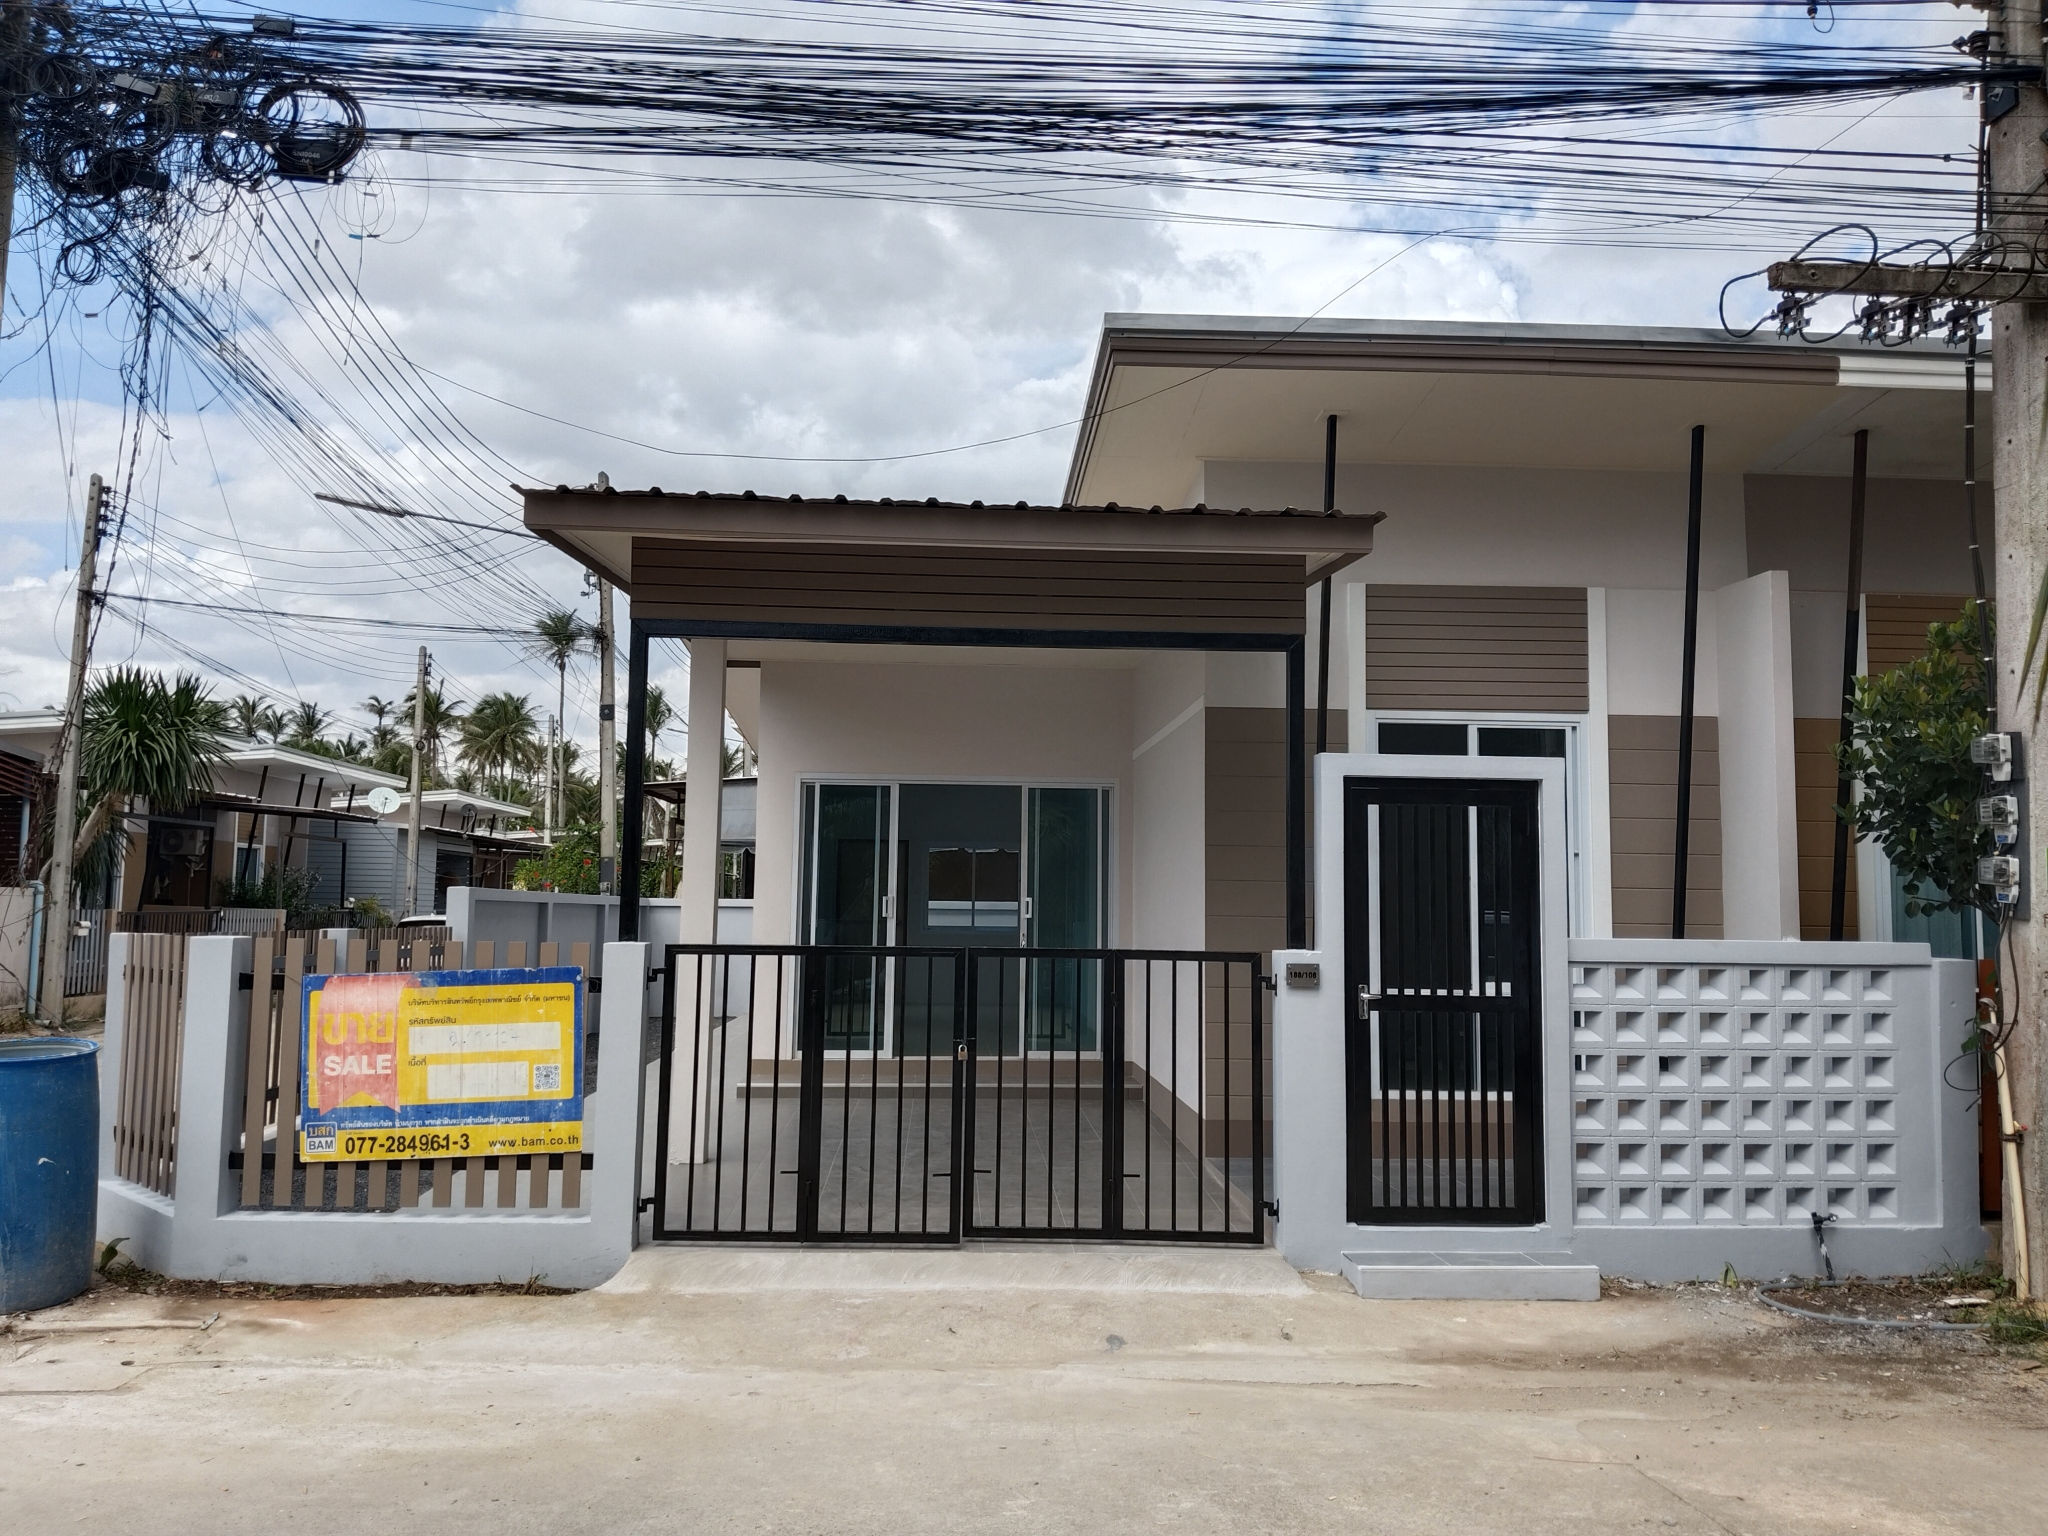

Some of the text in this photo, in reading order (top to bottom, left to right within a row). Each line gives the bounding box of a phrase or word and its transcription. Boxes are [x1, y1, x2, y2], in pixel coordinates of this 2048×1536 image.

[322, 1011, 394, 1045] ขาย
[324, 1054, 392, 1076] SALE
[309, 1126, 334, 1137] บสก
[308, 1140, 334, 1151] BAM
[345, 1133, 579, 1154] 077-284961-3 www.bam.co.th
